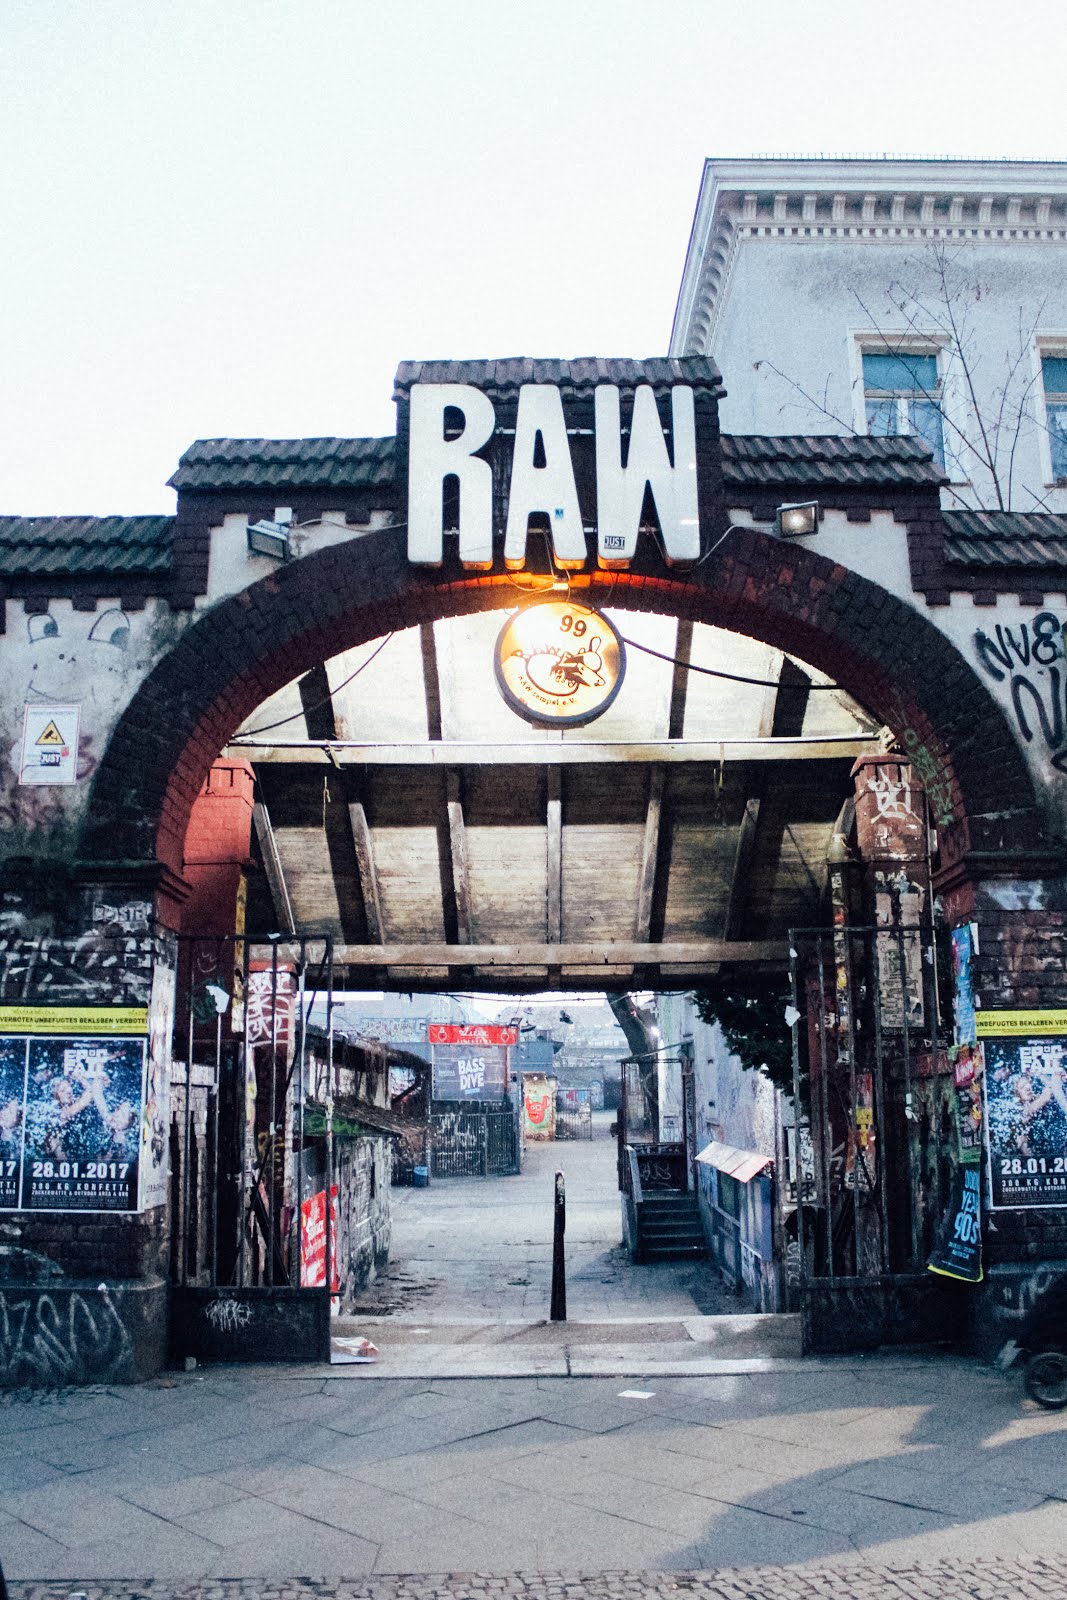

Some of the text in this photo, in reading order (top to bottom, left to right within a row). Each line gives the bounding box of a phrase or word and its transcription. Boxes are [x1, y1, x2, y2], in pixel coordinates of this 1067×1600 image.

[407, 384, 701, 568] RAW
[605, 536, 625, 547] JUST
[560, 615, 587, 637] 99
[41, 753, 60, 764] JUST
[457, 1057, 486, 1075] BASS
[460, 1071, 485, 1090] DIVE
[32, 1161, 130, 1179] 28.01.2017
[32, 1182, 129, 1191] 300 KG KONFETTI
[1001, 1179, 1020, 1187] 300
[1026, 1178, 1039, 1186] KG
